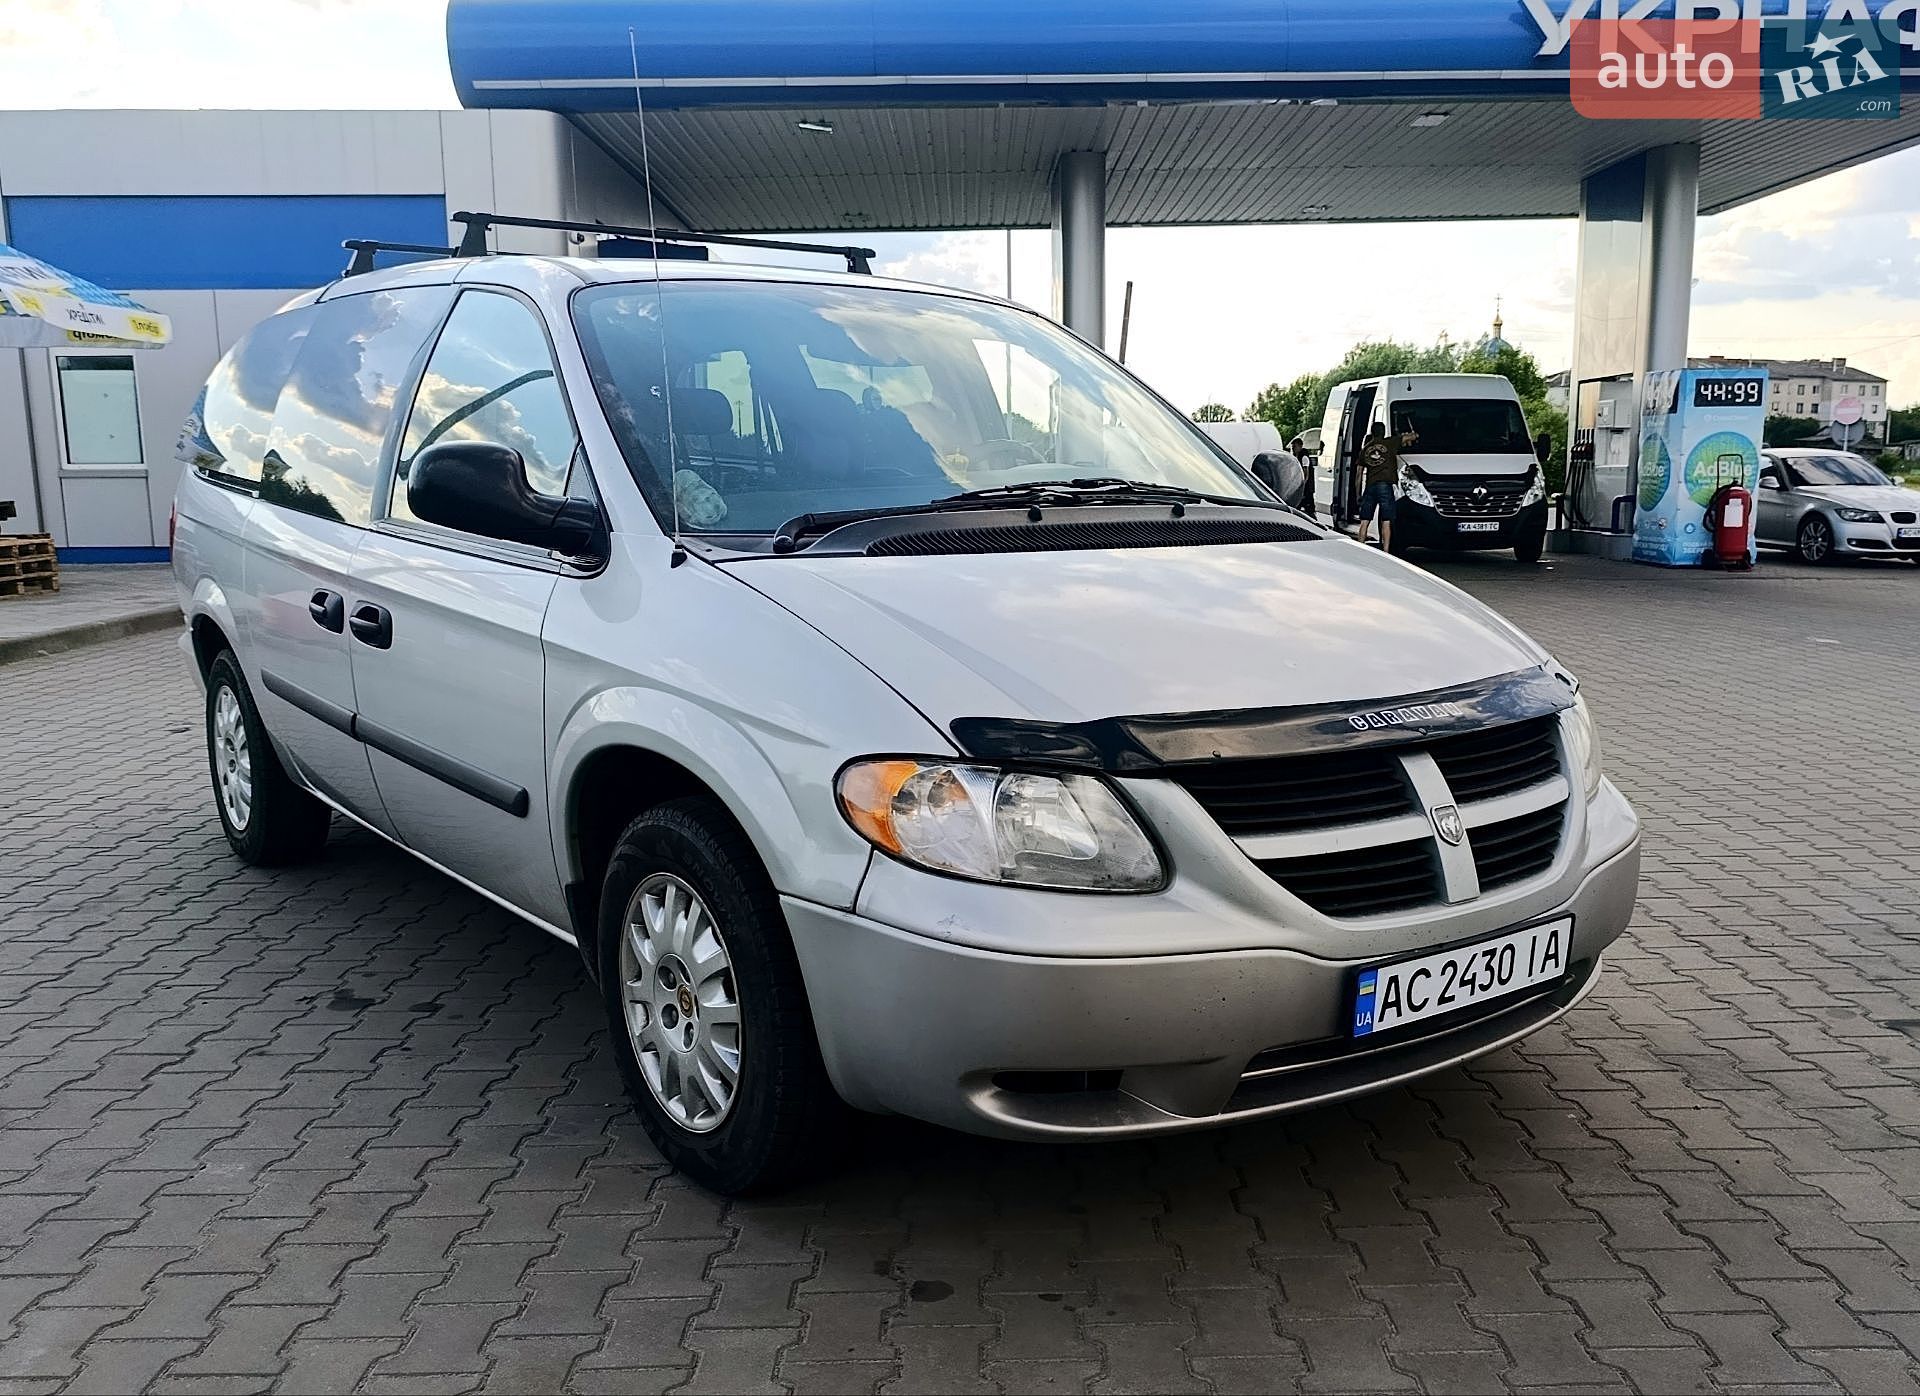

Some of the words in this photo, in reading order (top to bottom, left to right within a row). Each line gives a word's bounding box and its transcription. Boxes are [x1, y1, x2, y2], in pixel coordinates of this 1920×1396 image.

[1700, 382, 1759, 403] 44:99
[1694, 460, 1753, 477] AdBlue
[1348, 702, 1464, 731] CARAVAN
[1377, 967, 1432, 1023] AC
[1437, 943, 1516, 1006] 2430
[1527, 929, 1560, 978] IA
[1356, 1012, 1372, 1027] UA
